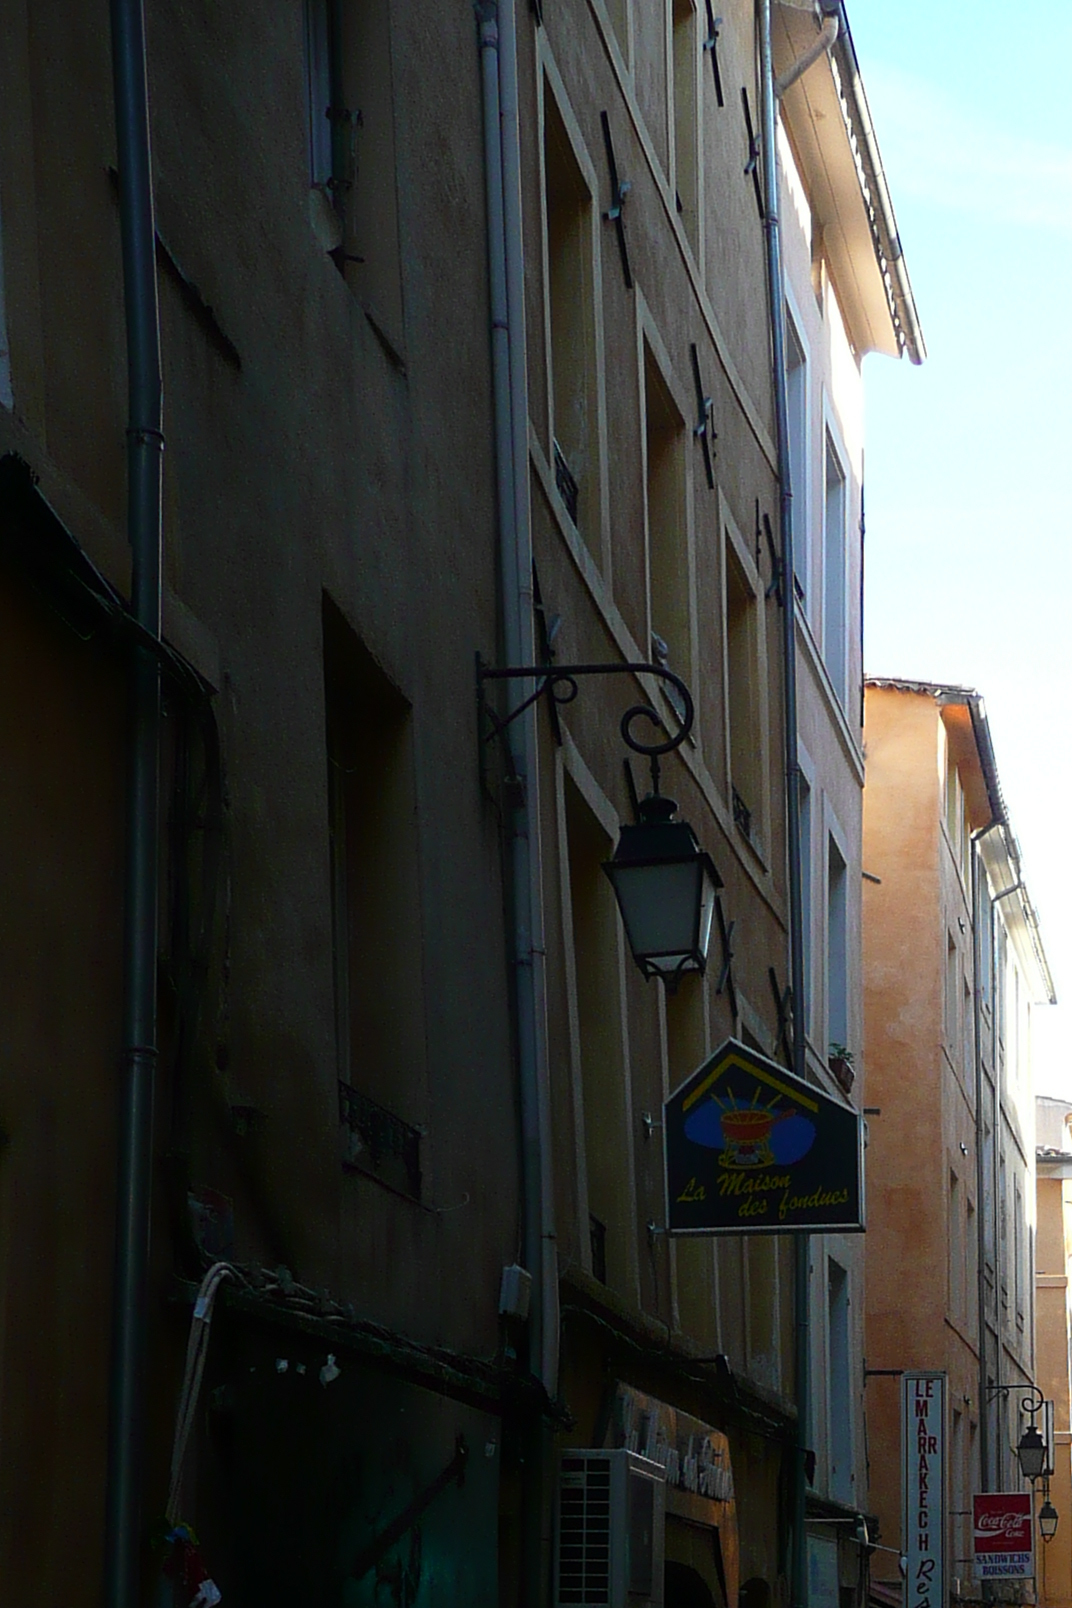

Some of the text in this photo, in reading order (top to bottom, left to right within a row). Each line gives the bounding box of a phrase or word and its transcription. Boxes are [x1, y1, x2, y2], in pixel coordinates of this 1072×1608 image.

[677, 1172, 792, 1203] La Maison
[737, 1185, 849, 1220] des fondues
[915, 1379, 934, 1398] LE
[915, 1400, 937, 1551] MARRAKECH
[977, 1512, 1024, 1530] Coca-Cola
[982, 1564, 1025, 1575] BOISSONS
